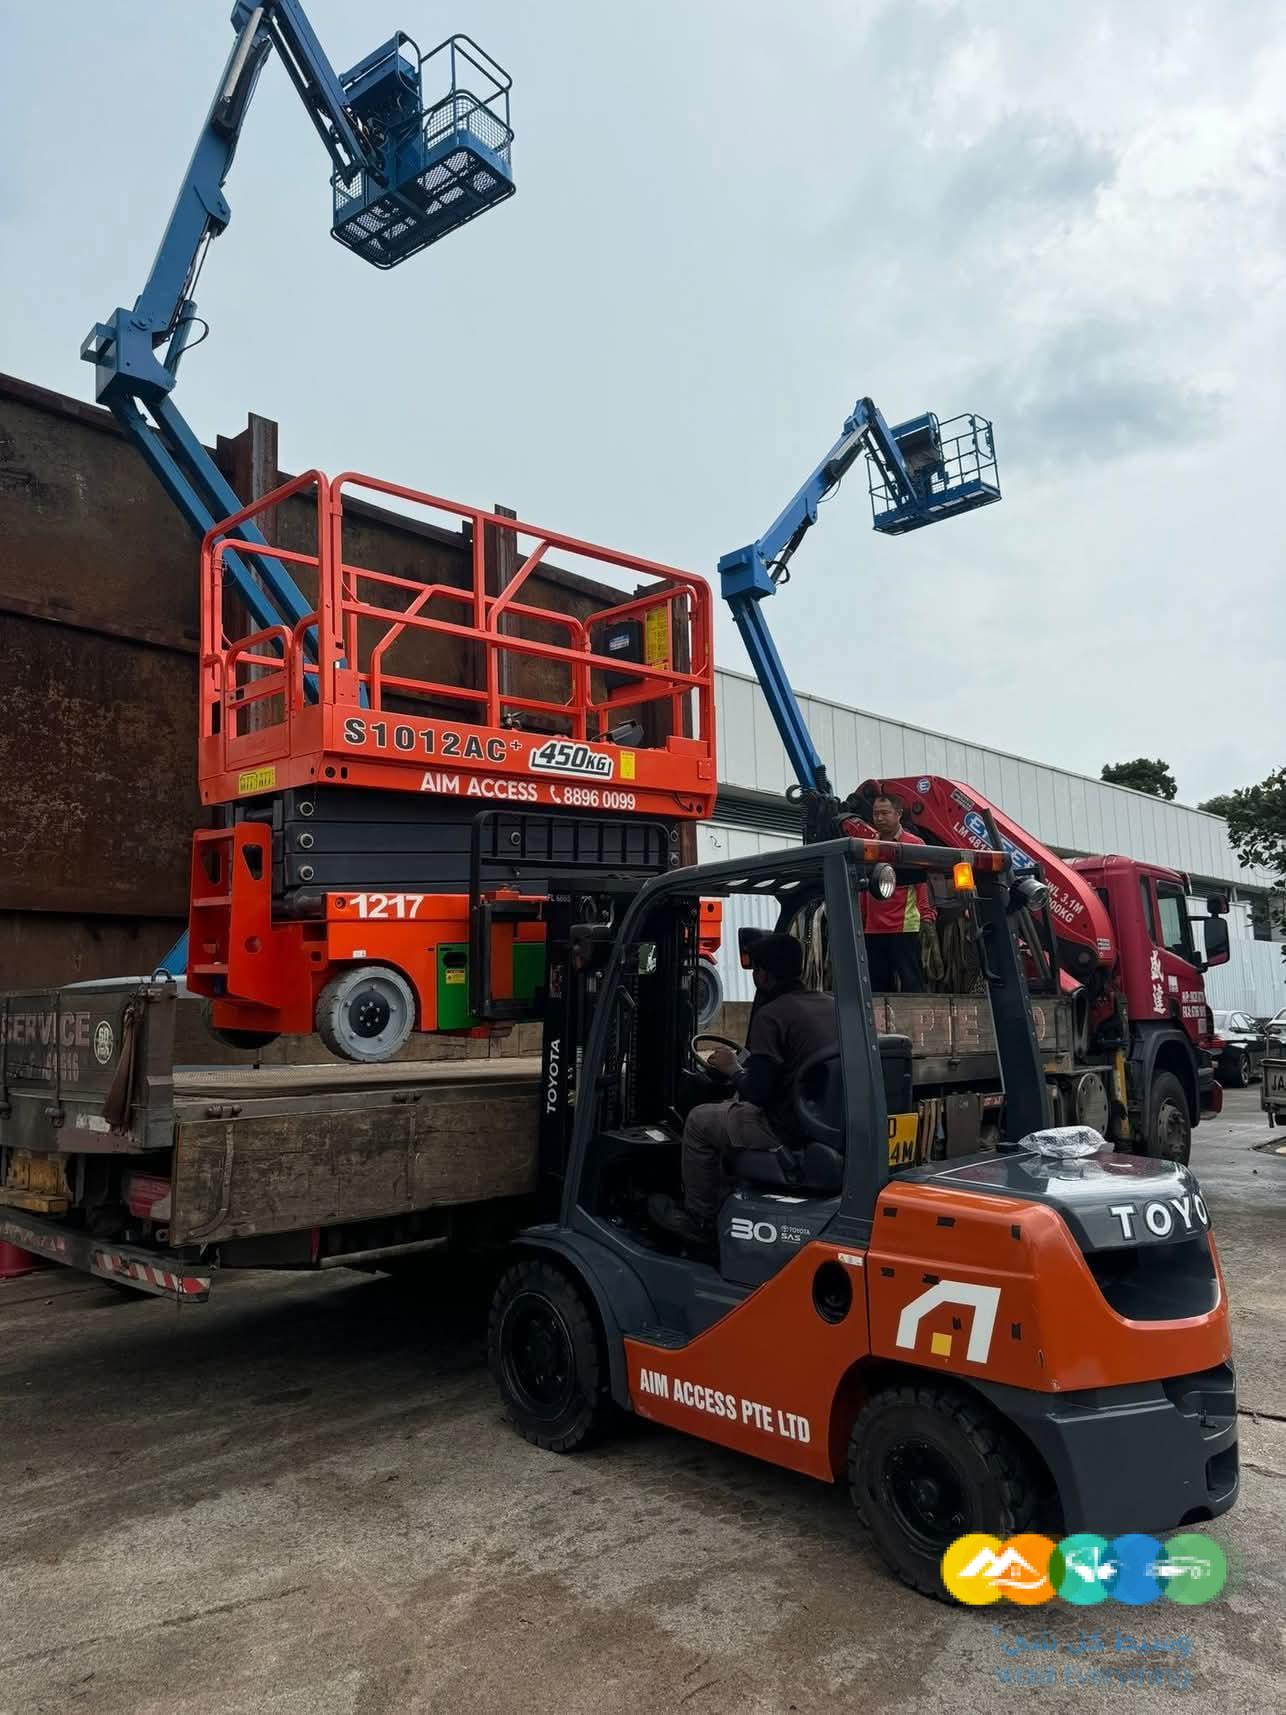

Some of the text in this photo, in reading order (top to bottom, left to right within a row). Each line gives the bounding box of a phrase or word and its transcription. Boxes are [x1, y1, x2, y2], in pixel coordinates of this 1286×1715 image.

[539, 742, 608, 771] 450KG
[420, 772, 636, 810] AIM ACCESS 8896 0099
[953, 822, 969, 838] LM
[350, 894, 424, 919] 1217
[1044, 878, 1084, 914] WL 3.1M
[1048, 896, 1075, 923] 00KG
[546, 1039, 561, 1114] TOYOTA
[731, 1217, 778, 1244] 30
[640, 1368, 811, 1443] AIM ACCESS PTE LTD
